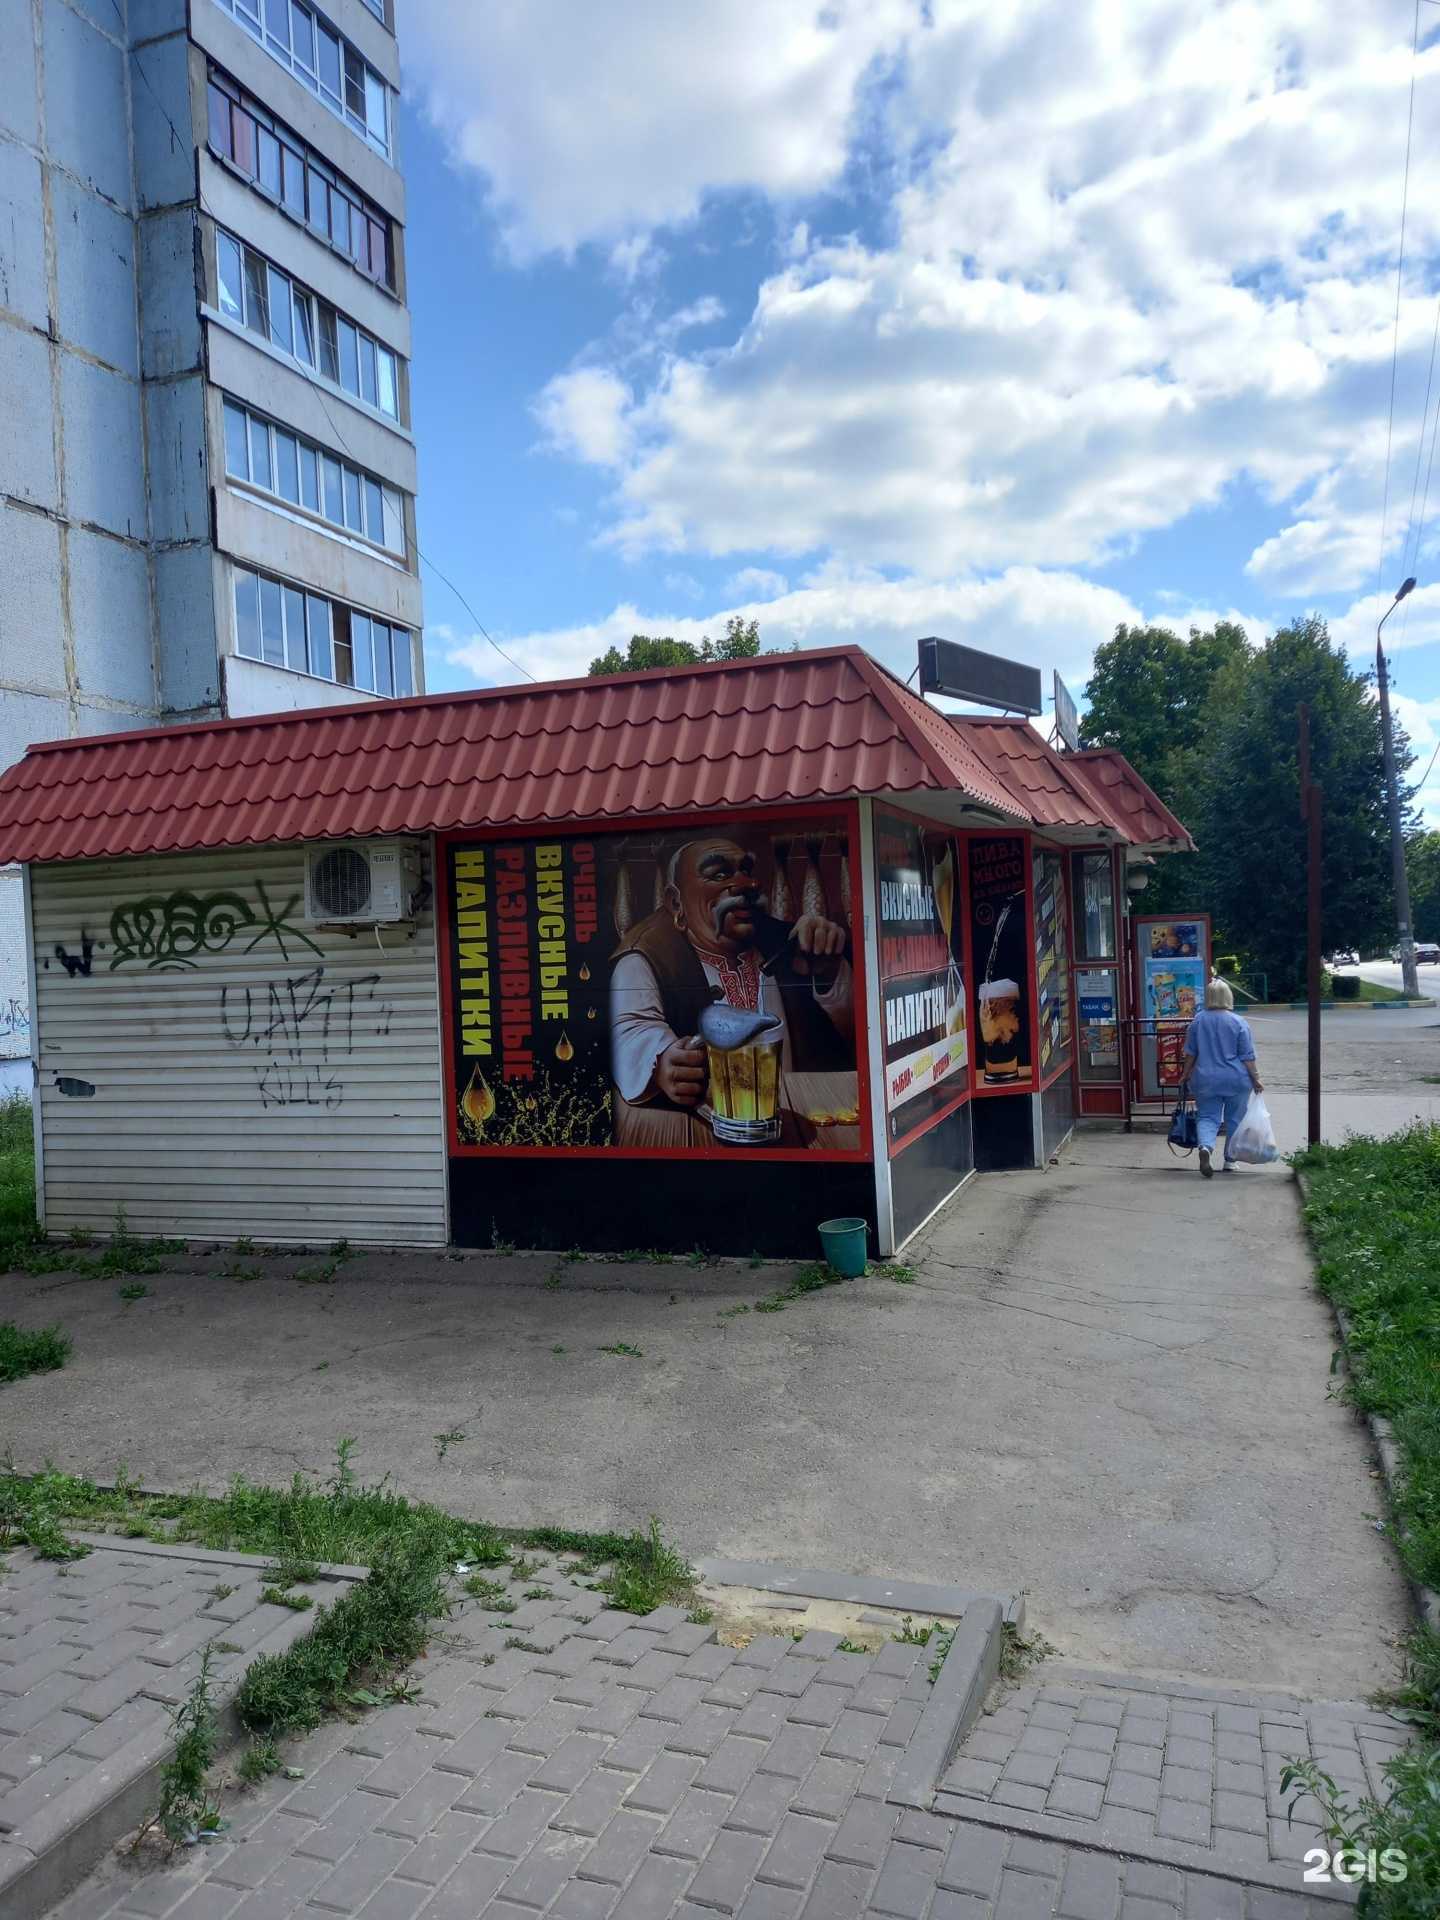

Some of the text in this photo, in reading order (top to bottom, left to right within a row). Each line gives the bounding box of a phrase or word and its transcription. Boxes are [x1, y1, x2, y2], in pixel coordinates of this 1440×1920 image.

[454, 850, 492, 1056] НАПИТКИ
[535, 844, 569, 1021] ВКУСНЫЕ
[572, 842, 599, 943] ОЧЕНЬ
[881, 880, 934, 921] ВКУСНЫЕ
[495, 847, 534, 1083] РАЗЛИВНЫЕ
[885, 986, 945, 1047] НАПИТКИ
